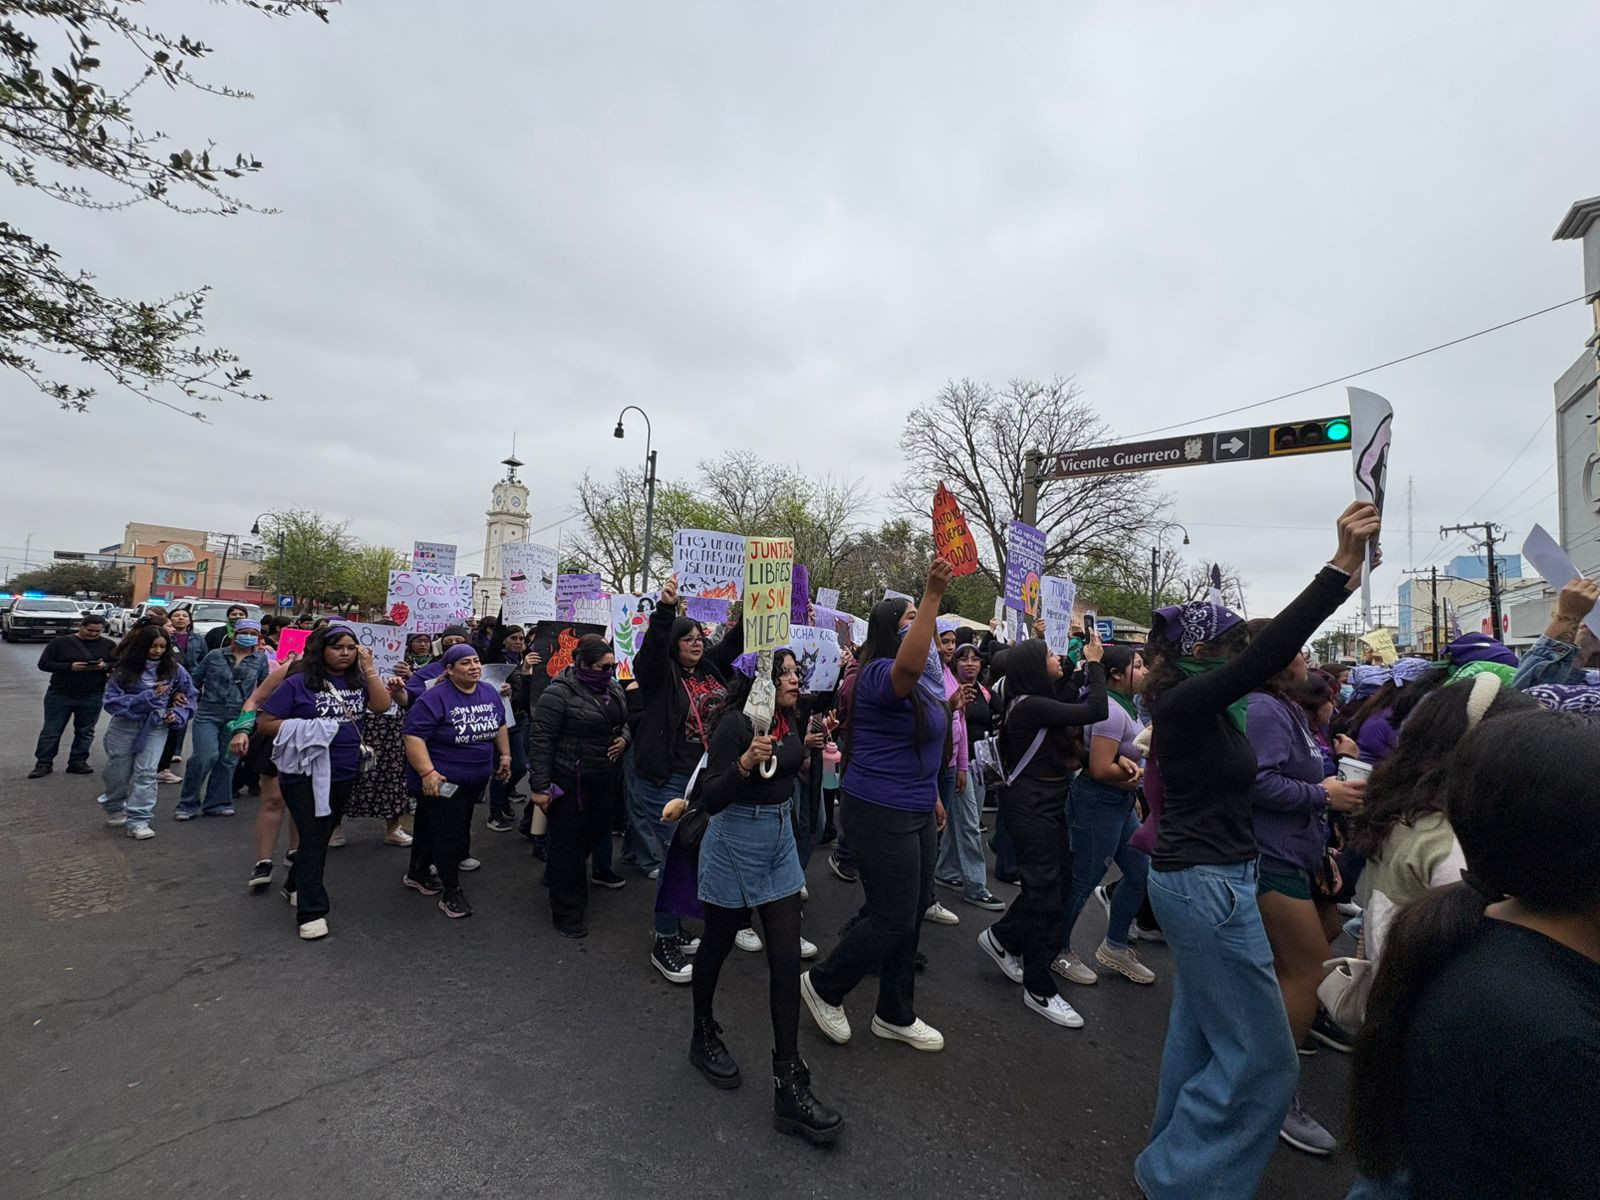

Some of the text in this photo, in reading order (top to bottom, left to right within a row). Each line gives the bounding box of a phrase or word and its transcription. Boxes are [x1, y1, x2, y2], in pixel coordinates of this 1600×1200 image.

[1061, 448, 1180, 472] Vicente Guerrero
[751, 541, 793, 560] JUNTAS
[749, 561, 791, 586] LIBRES
[395, 573, 446, 597] Somos
[507, 599, 525, 607] Entre
[751, 591, 760, 611] Y
[427, 613, 441, 621] que
[455, 608, 469, 619] NO
[360, 626, 386, 648] 8M
[745, 612, 789, 648] MIEDO
[790, 627, 814, 641] UCHA
[383, 654, 400, 662] que
[320, 706, 330, 717] Y
[454, 703, 493, 715] SIN MIEDO
[453, 713, 498, 725] libres
[458, 721, 499, 735] Y VIVAS
[455, 735, 470, 745] NOS
